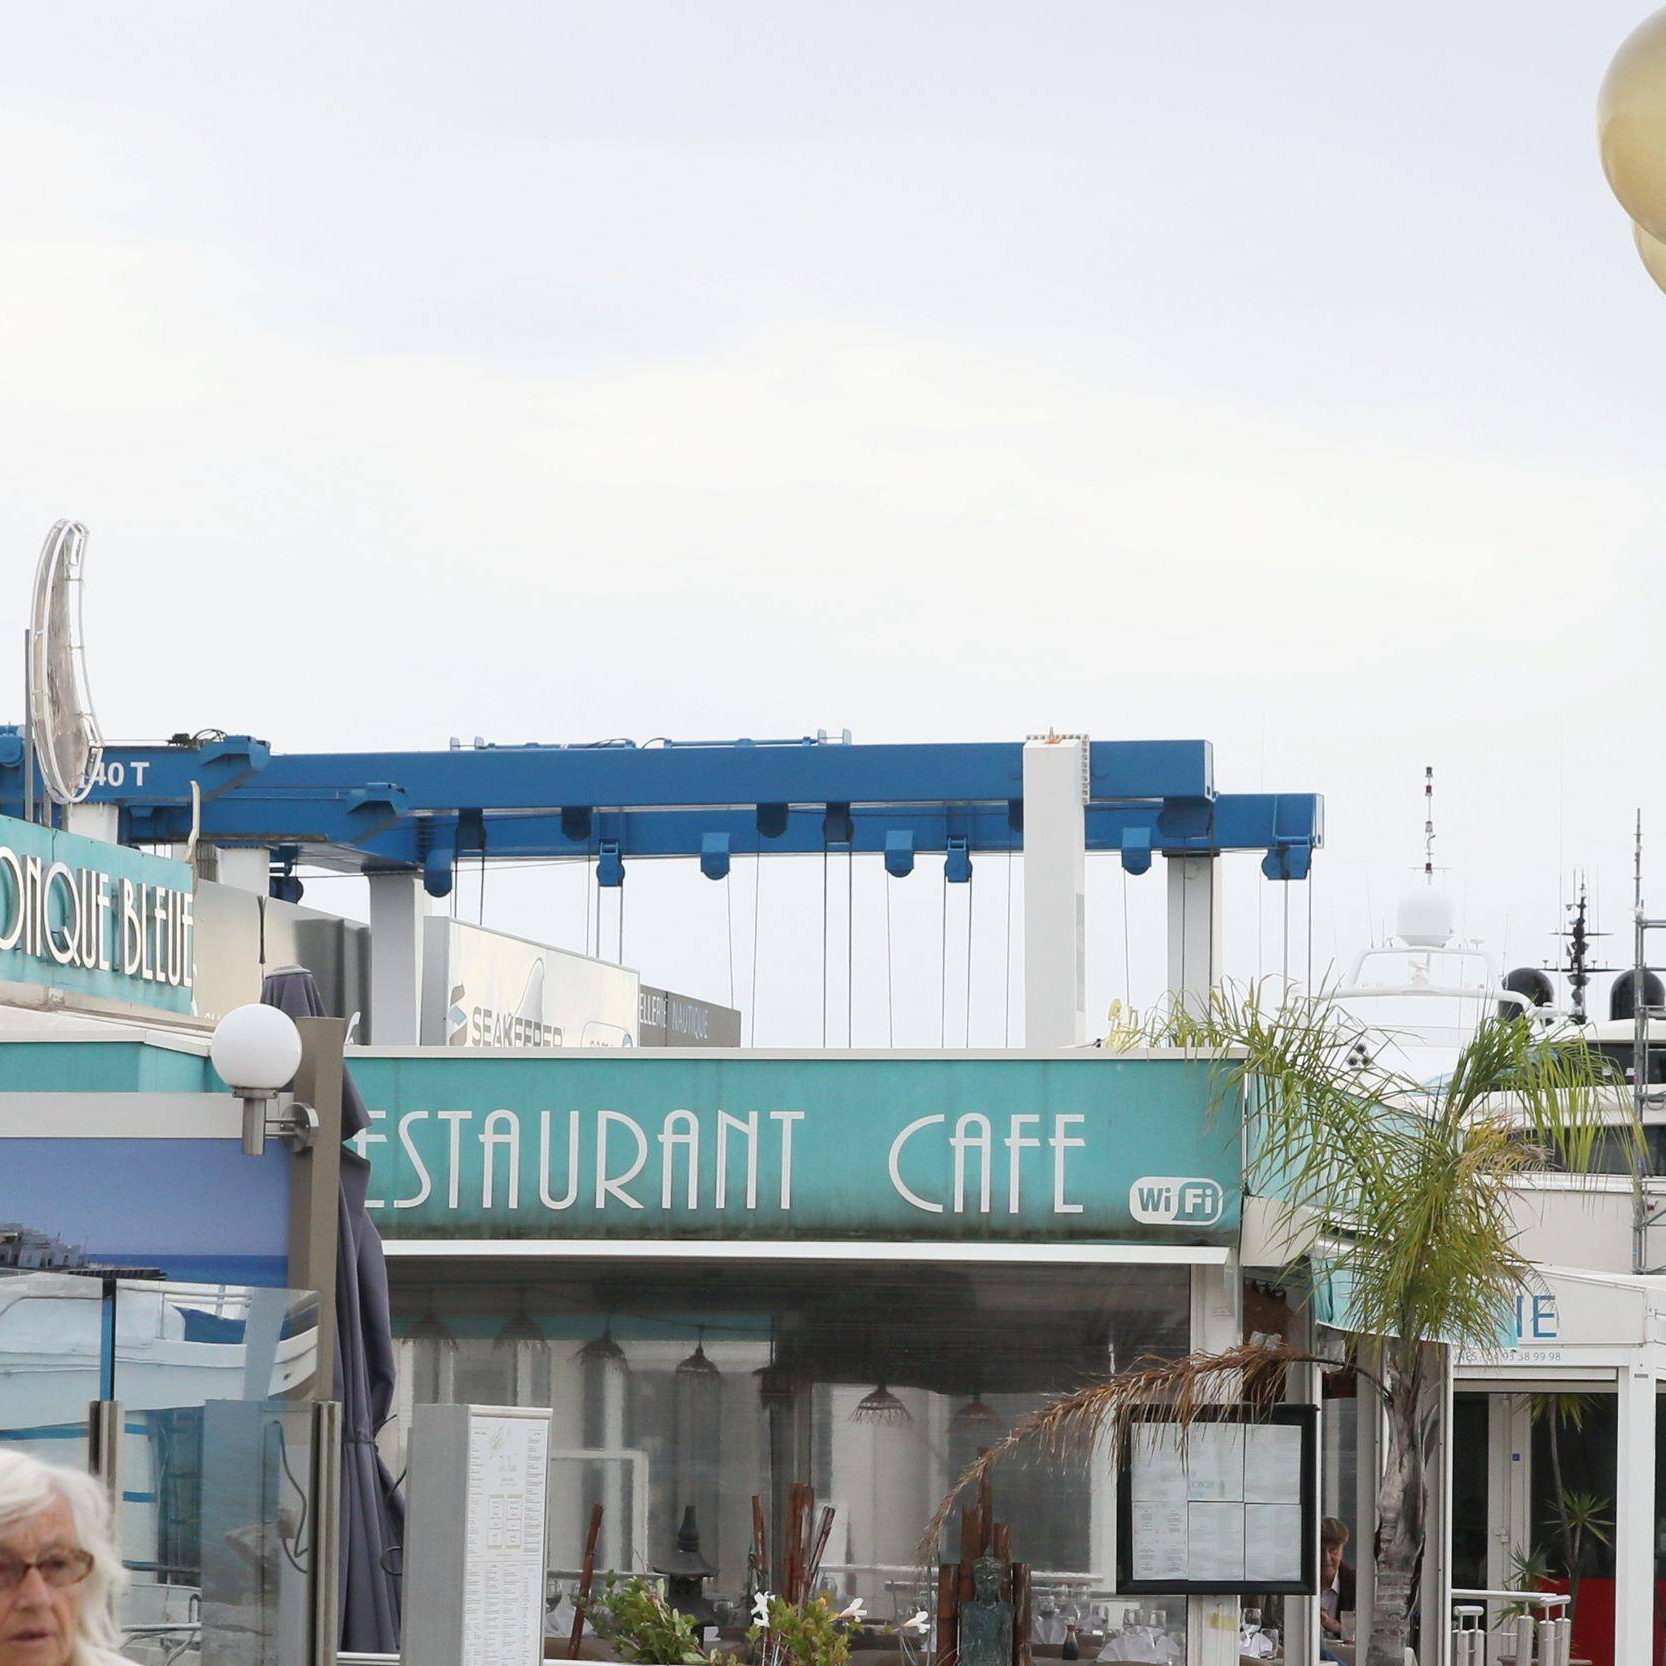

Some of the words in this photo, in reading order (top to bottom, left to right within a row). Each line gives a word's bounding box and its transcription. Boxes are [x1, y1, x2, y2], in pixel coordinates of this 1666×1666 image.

[130, 762, 150, 786] T
[120, 877, 194, 988] BLEUE
[351, 1110, 805, 1211] ESTAURANT
[889, 1112, 1087, 1214] CAFE
